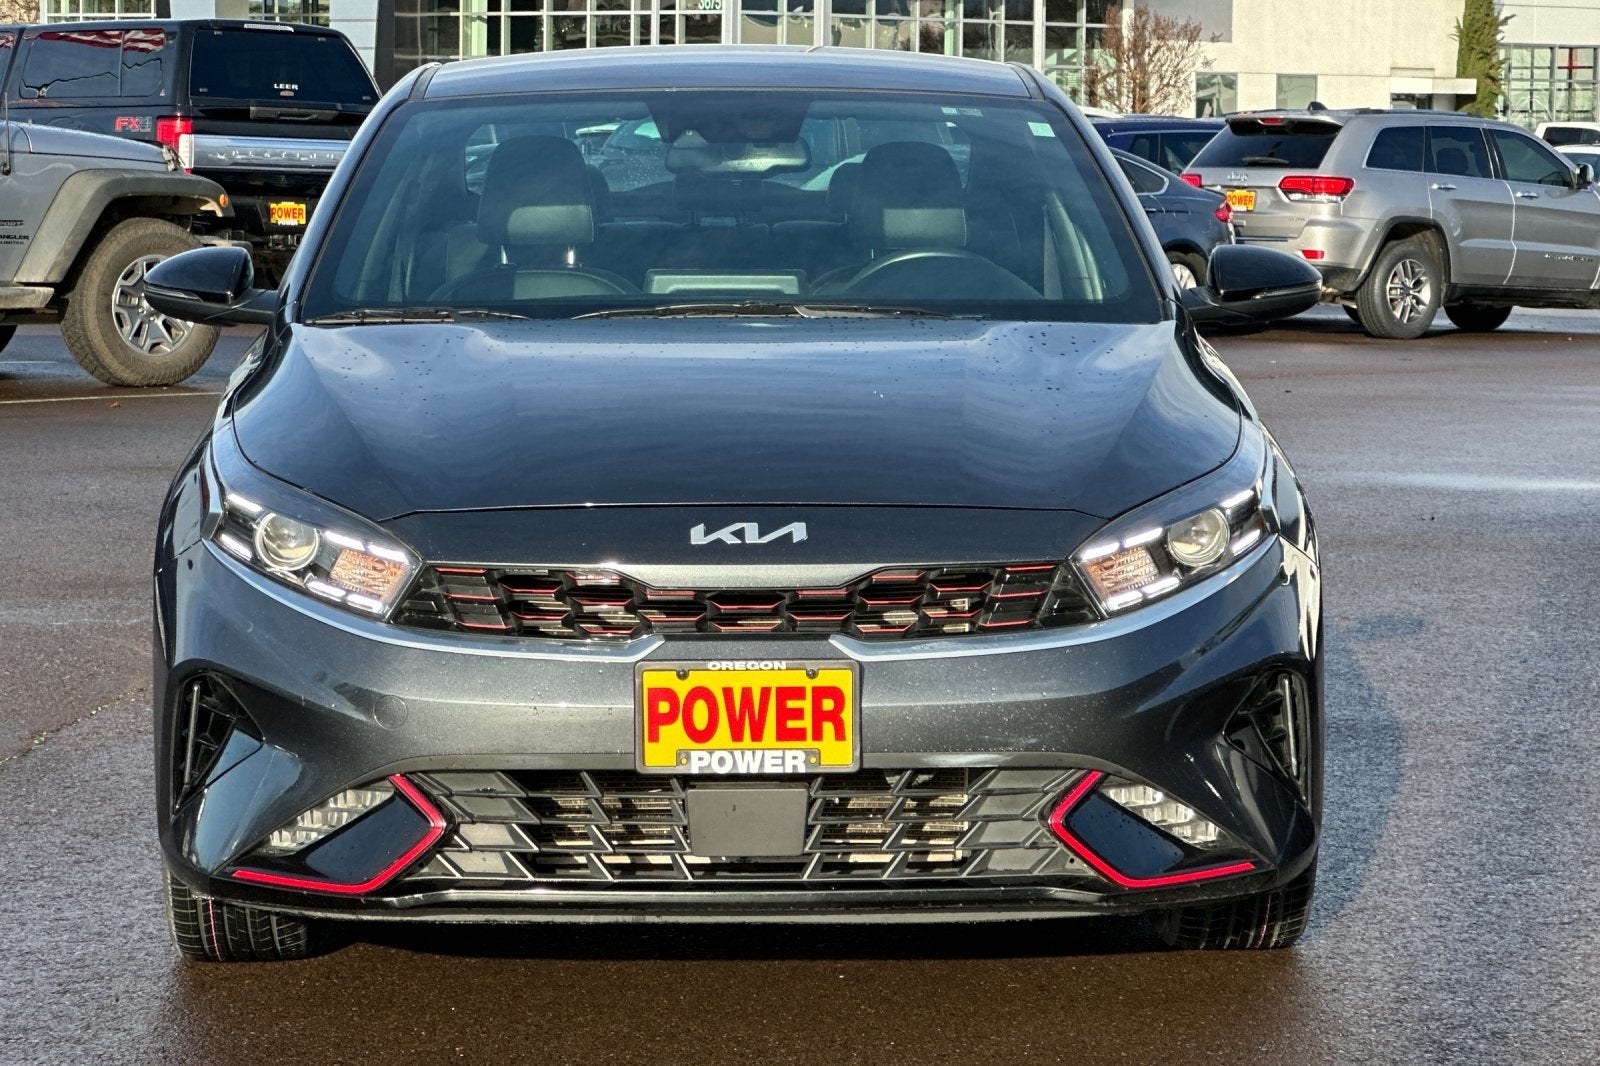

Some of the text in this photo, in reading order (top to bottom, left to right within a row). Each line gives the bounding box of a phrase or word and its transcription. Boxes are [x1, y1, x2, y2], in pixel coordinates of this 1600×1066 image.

[114, 116, 152, 132] FX4
[1227, 194, 1254, 206] POWER
[270, 207, 304, 219] POWER
[690, 521, 808, 544] KIA
[707, 661, 787, 671] OREGON
[647, 685, 847, 744] POWER
[690, 750, 806, 774] POWER
